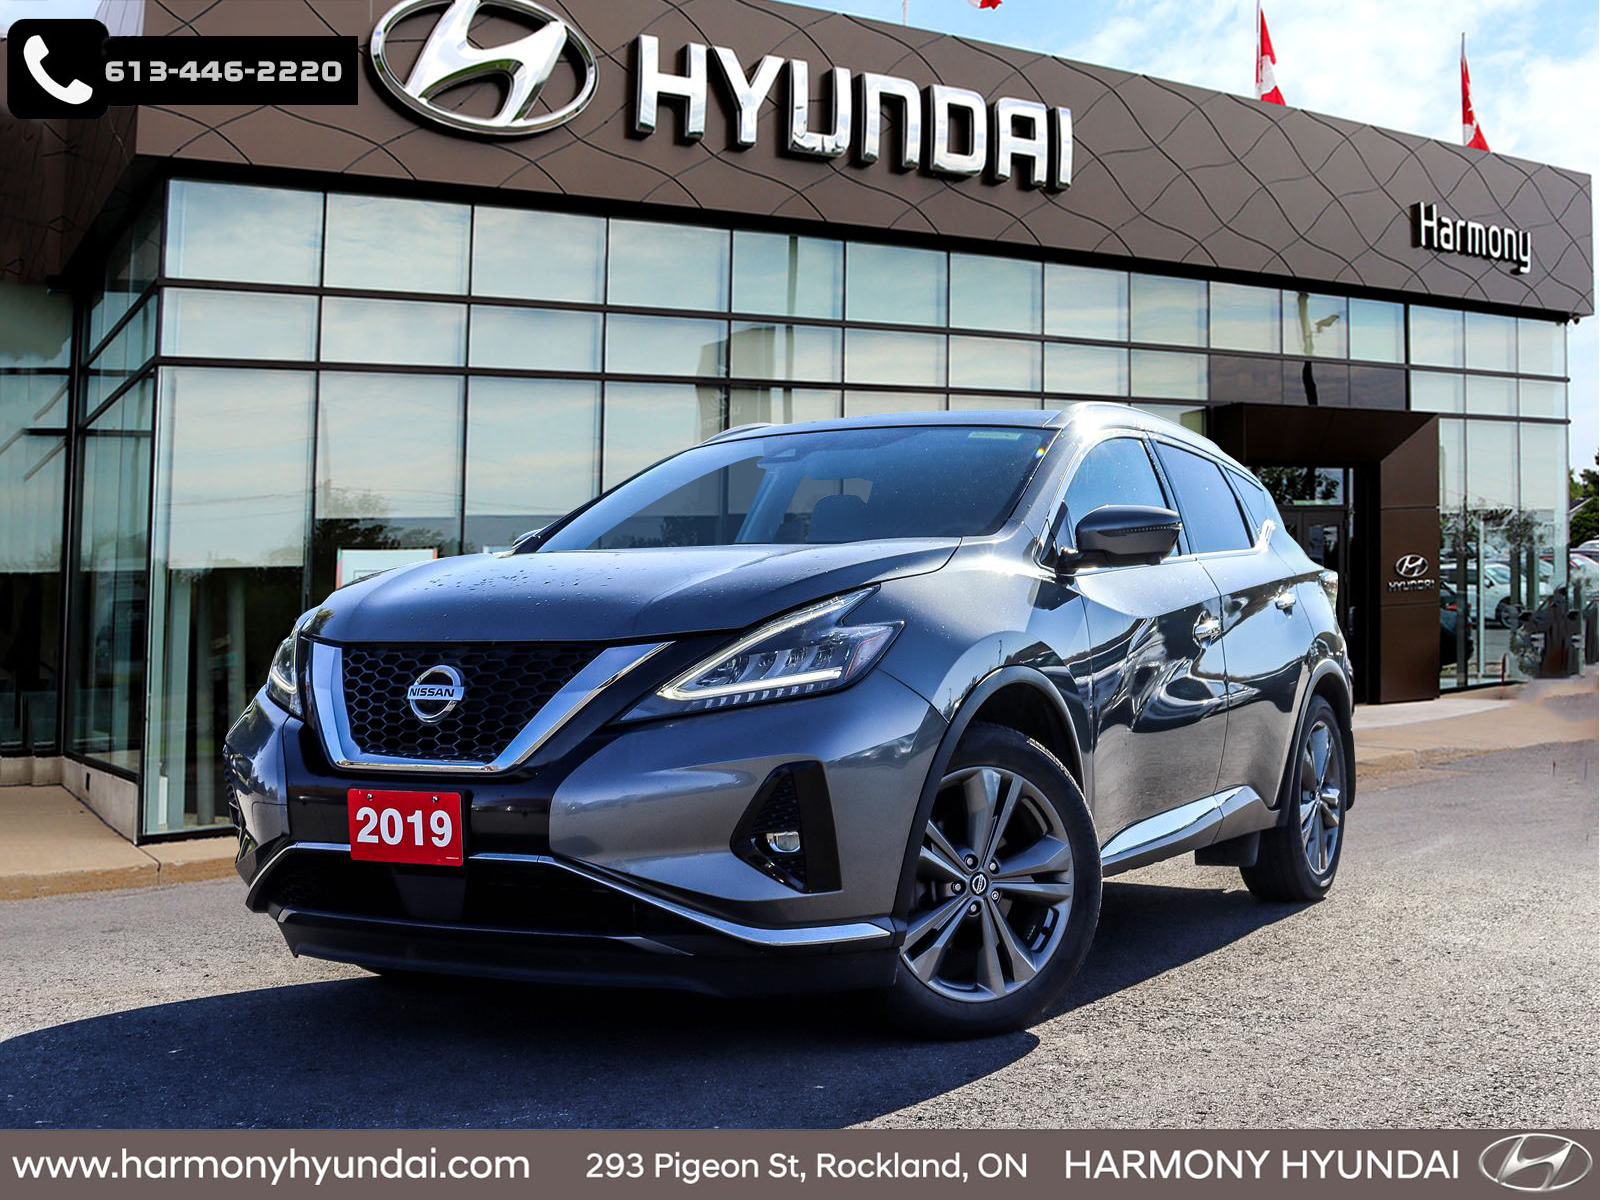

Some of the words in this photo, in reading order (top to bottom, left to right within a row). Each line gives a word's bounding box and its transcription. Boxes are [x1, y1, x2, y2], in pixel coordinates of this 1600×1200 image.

[635, 34, 1073, 190] HYUNDAI
[1420, 201, 1531, 273] Harmony
[409, 687, 455, 698] NISSAN
[356, 806, 452, 848] 2019
